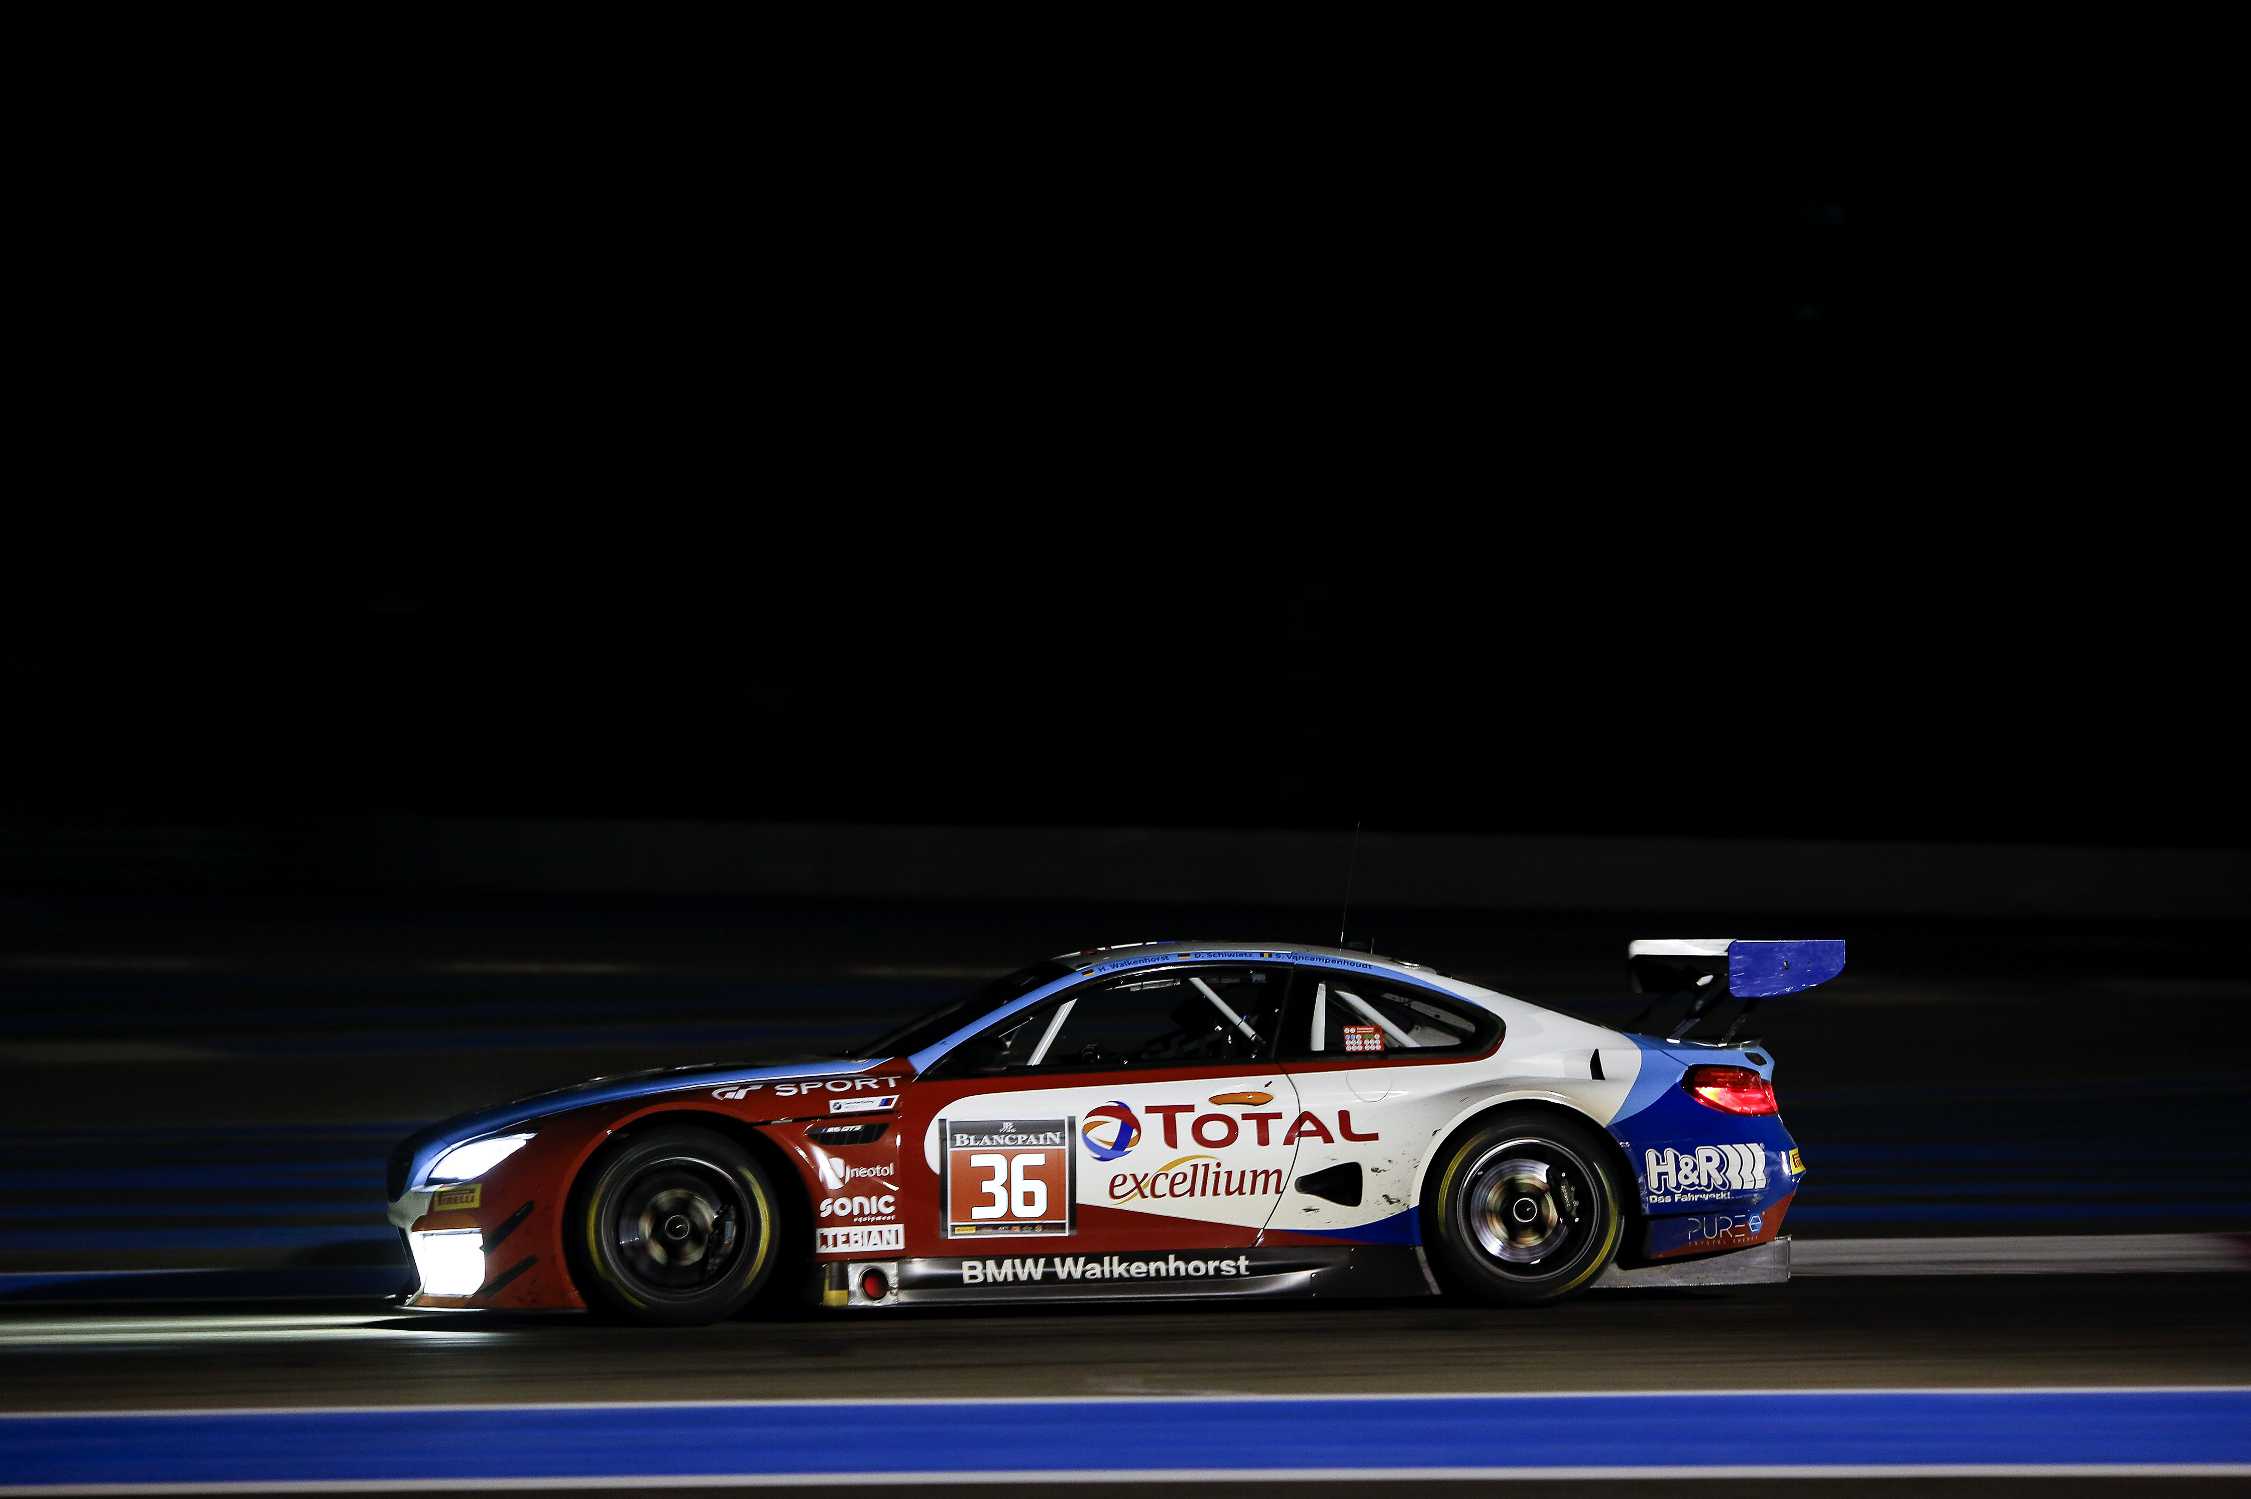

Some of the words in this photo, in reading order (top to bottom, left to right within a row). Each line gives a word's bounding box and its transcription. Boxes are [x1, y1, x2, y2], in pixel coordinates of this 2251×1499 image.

[775, 1076, 902, 1097] SPORT
[953, 1131, 1063, 1147] BLANCPAIN
[1145, 1104, 1379, 1149] TOTAL
[970, 1153, 1048, 1220] 36
[1108, 1161, 1284, 1201] excellium
[1646, 1147, 1729, 1194] H&R
[1648, 1194, 1672, 1204] Das
[960, 1257, 1047, 1285] BMW
[1053, 1253, 1251, 1281] Walkenhorst
